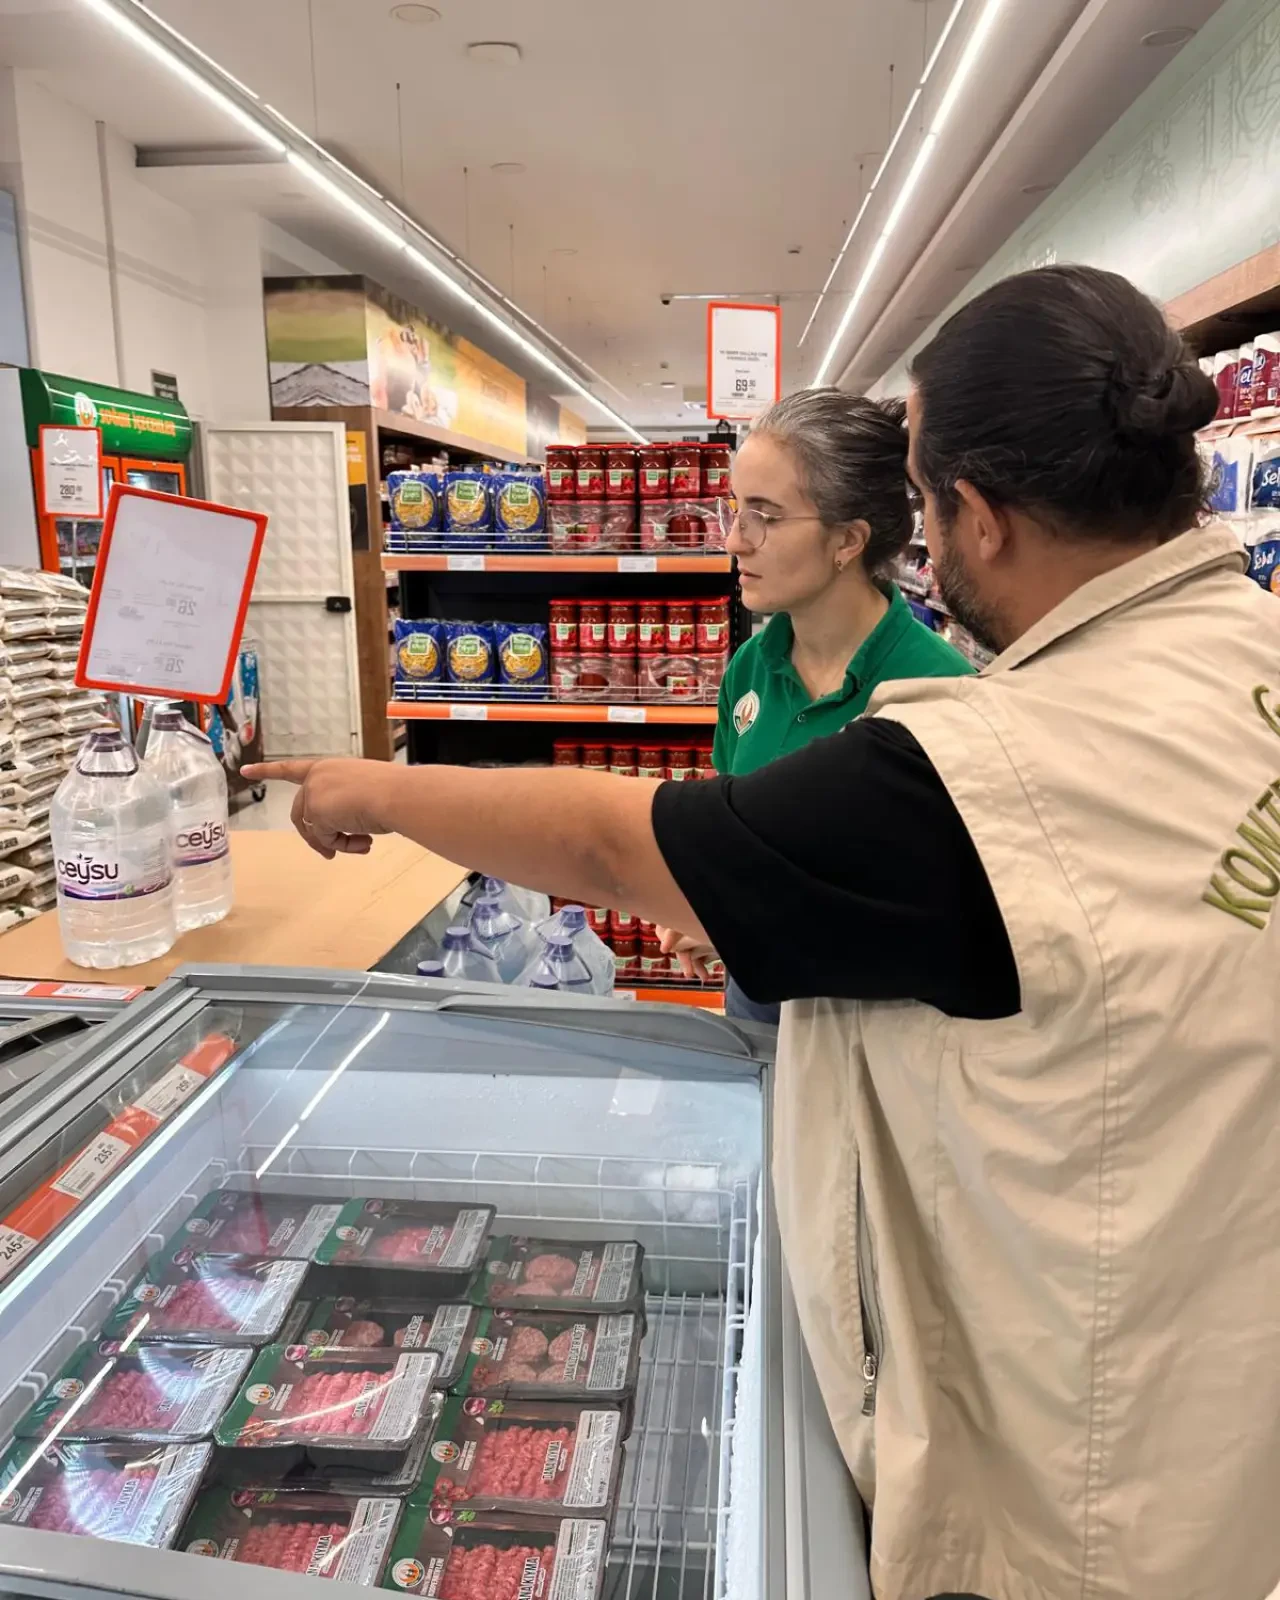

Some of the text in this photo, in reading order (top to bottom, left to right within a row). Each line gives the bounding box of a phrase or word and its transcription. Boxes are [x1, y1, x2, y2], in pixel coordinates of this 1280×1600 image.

[735, 379, 748, 392] 69
[176, 821, 226, 849] ceysu
[1201, 778, 1280, 931] KONT
[57, 854, 119, 885] ceysu
[94, 1148, 113, 1164] 235
[0, 1241, 23, 1261] 245
[523, 1557, 539, 1584] KIYMA
